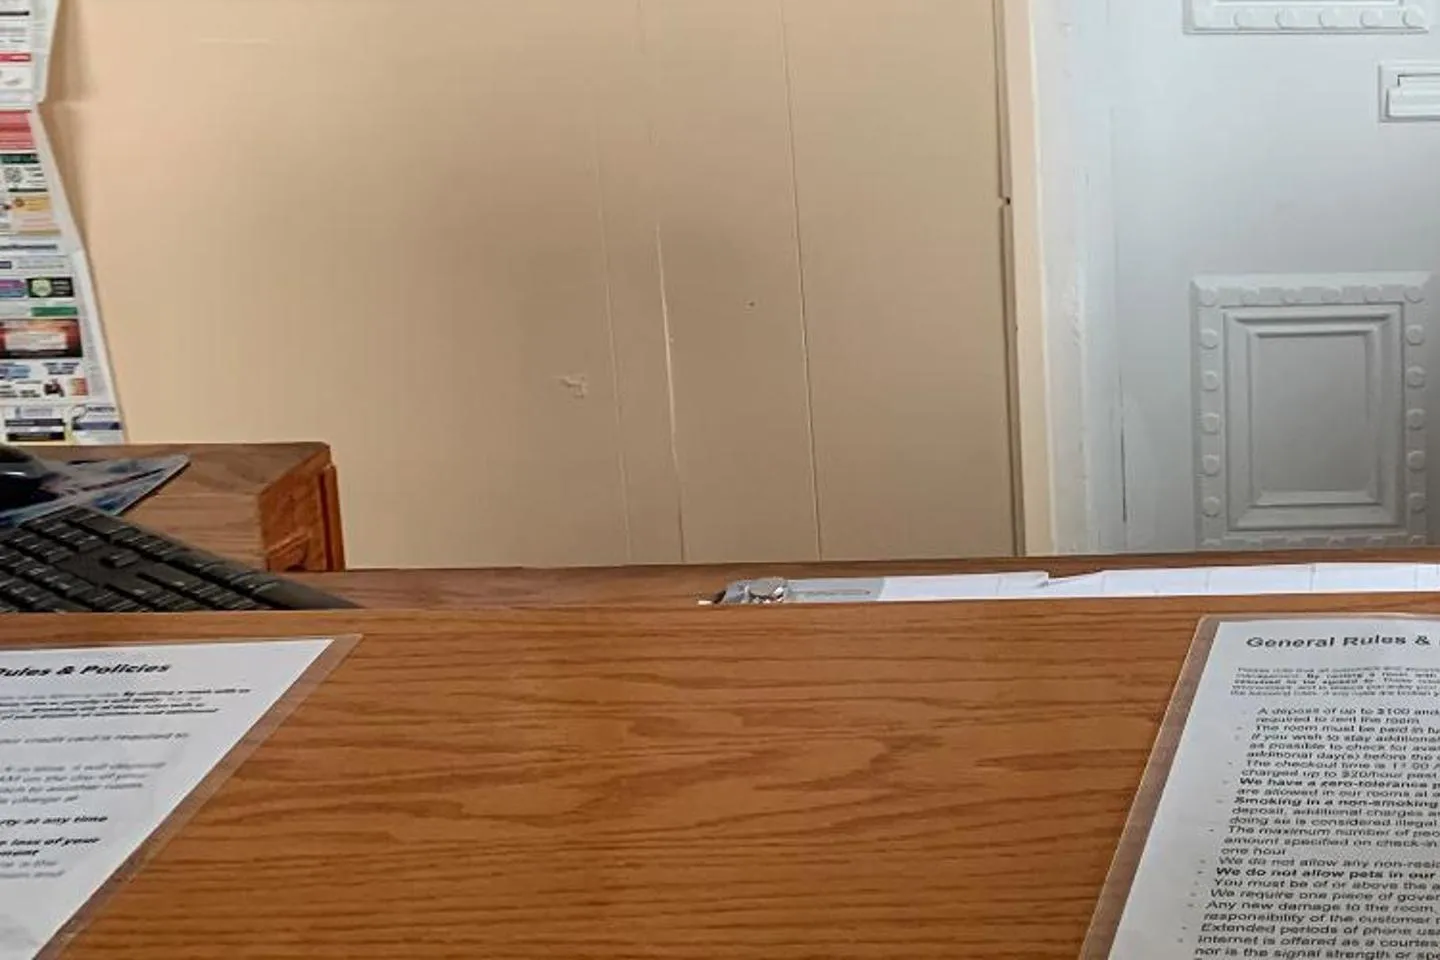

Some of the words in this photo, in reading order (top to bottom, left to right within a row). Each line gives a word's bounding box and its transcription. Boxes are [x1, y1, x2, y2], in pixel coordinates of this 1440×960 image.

[1246, 636, 1335, 648] General
[1342, 635, 1406, 647] Rules
[1414, 635, 1431, 646] &
[1216, 867, 1241, 876] We
[1246, 868, 1267, 876] do
[1271, 869, 1297, 877] not
[1302, 869, 1345, 878] allow
[1349, 870, 1383, 879] pets
